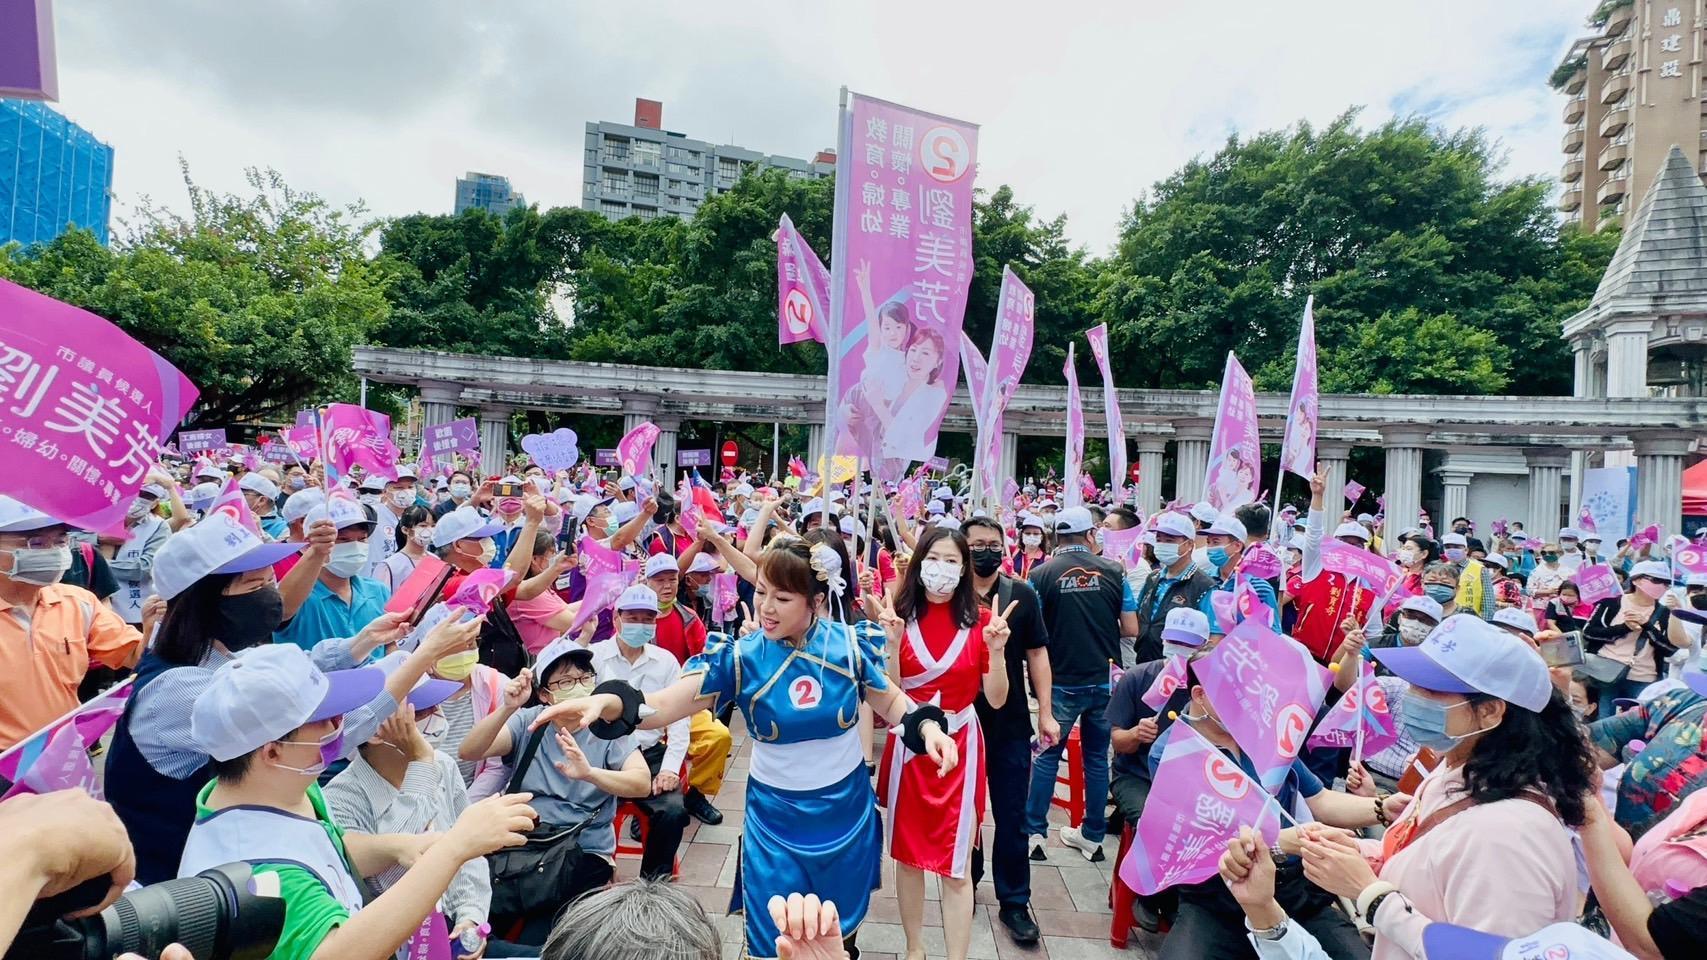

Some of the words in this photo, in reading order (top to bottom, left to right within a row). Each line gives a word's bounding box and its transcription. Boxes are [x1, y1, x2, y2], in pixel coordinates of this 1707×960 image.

[56, 345, 152, 415] 市議員候選人
[1060, 576, 1100, 588] TACA
[795, 681, 816, 703] 2
[1372, 690, 1386, 710] 2
